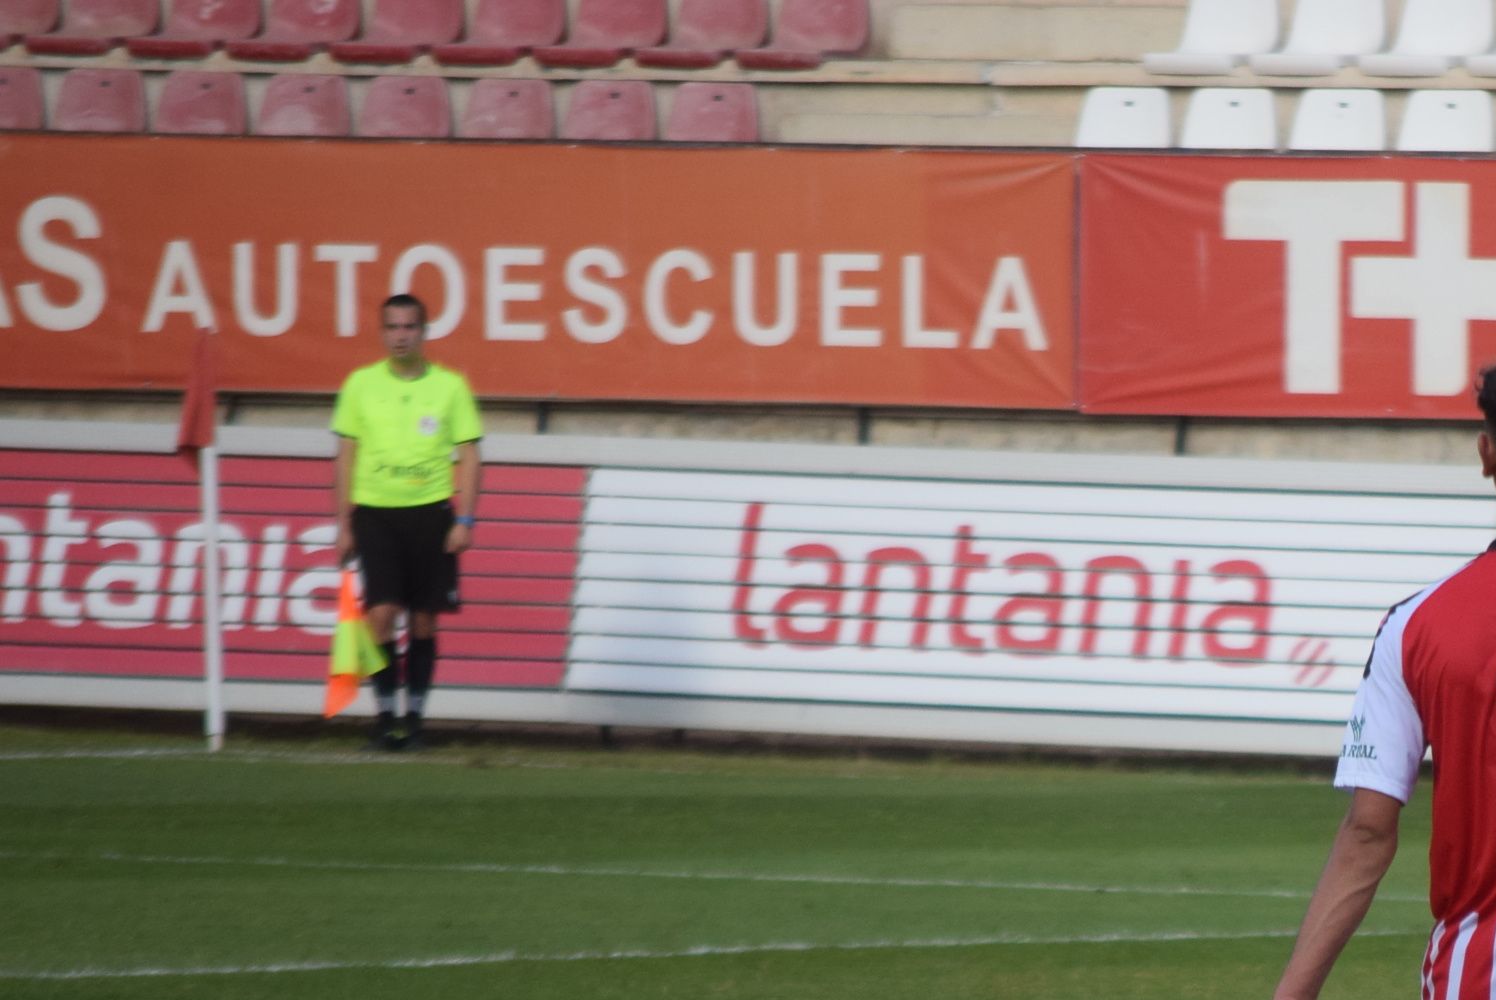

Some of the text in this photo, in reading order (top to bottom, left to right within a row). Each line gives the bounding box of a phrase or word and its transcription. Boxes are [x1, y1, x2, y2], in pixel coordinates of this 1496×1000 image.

[0, 193, 1049, 352] S AUTOESCUELA
[730, 501, 1273, 669] lantania
